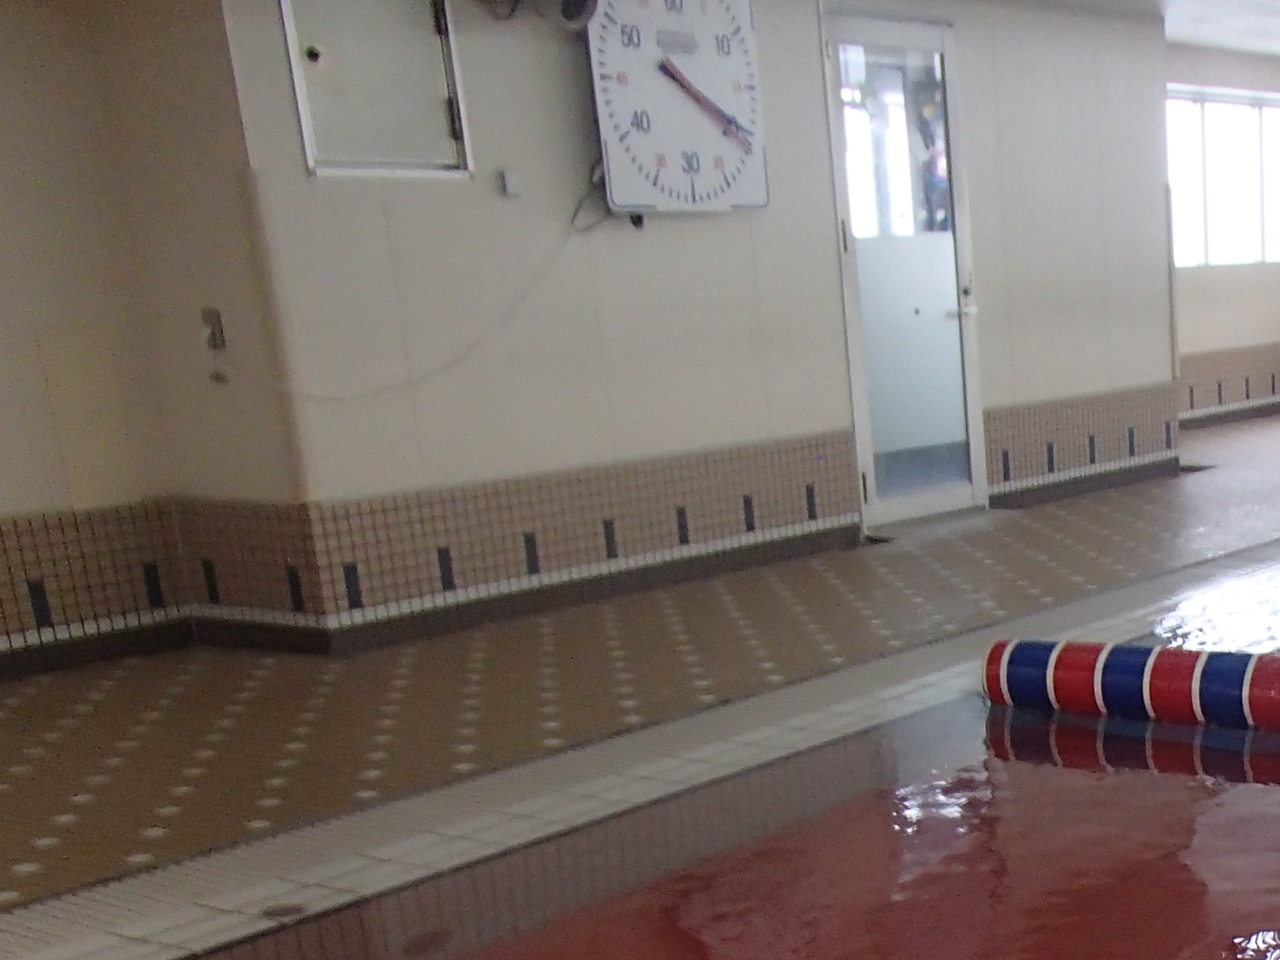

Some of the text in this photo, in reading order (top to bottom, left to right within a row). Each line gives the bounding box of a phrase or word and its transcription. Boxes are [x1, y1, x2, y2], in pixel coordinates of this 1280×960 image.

[715, 34, 731, 56] 10
[631, 110, 651, 134] 40
[681, 151, 700, 174] 30
